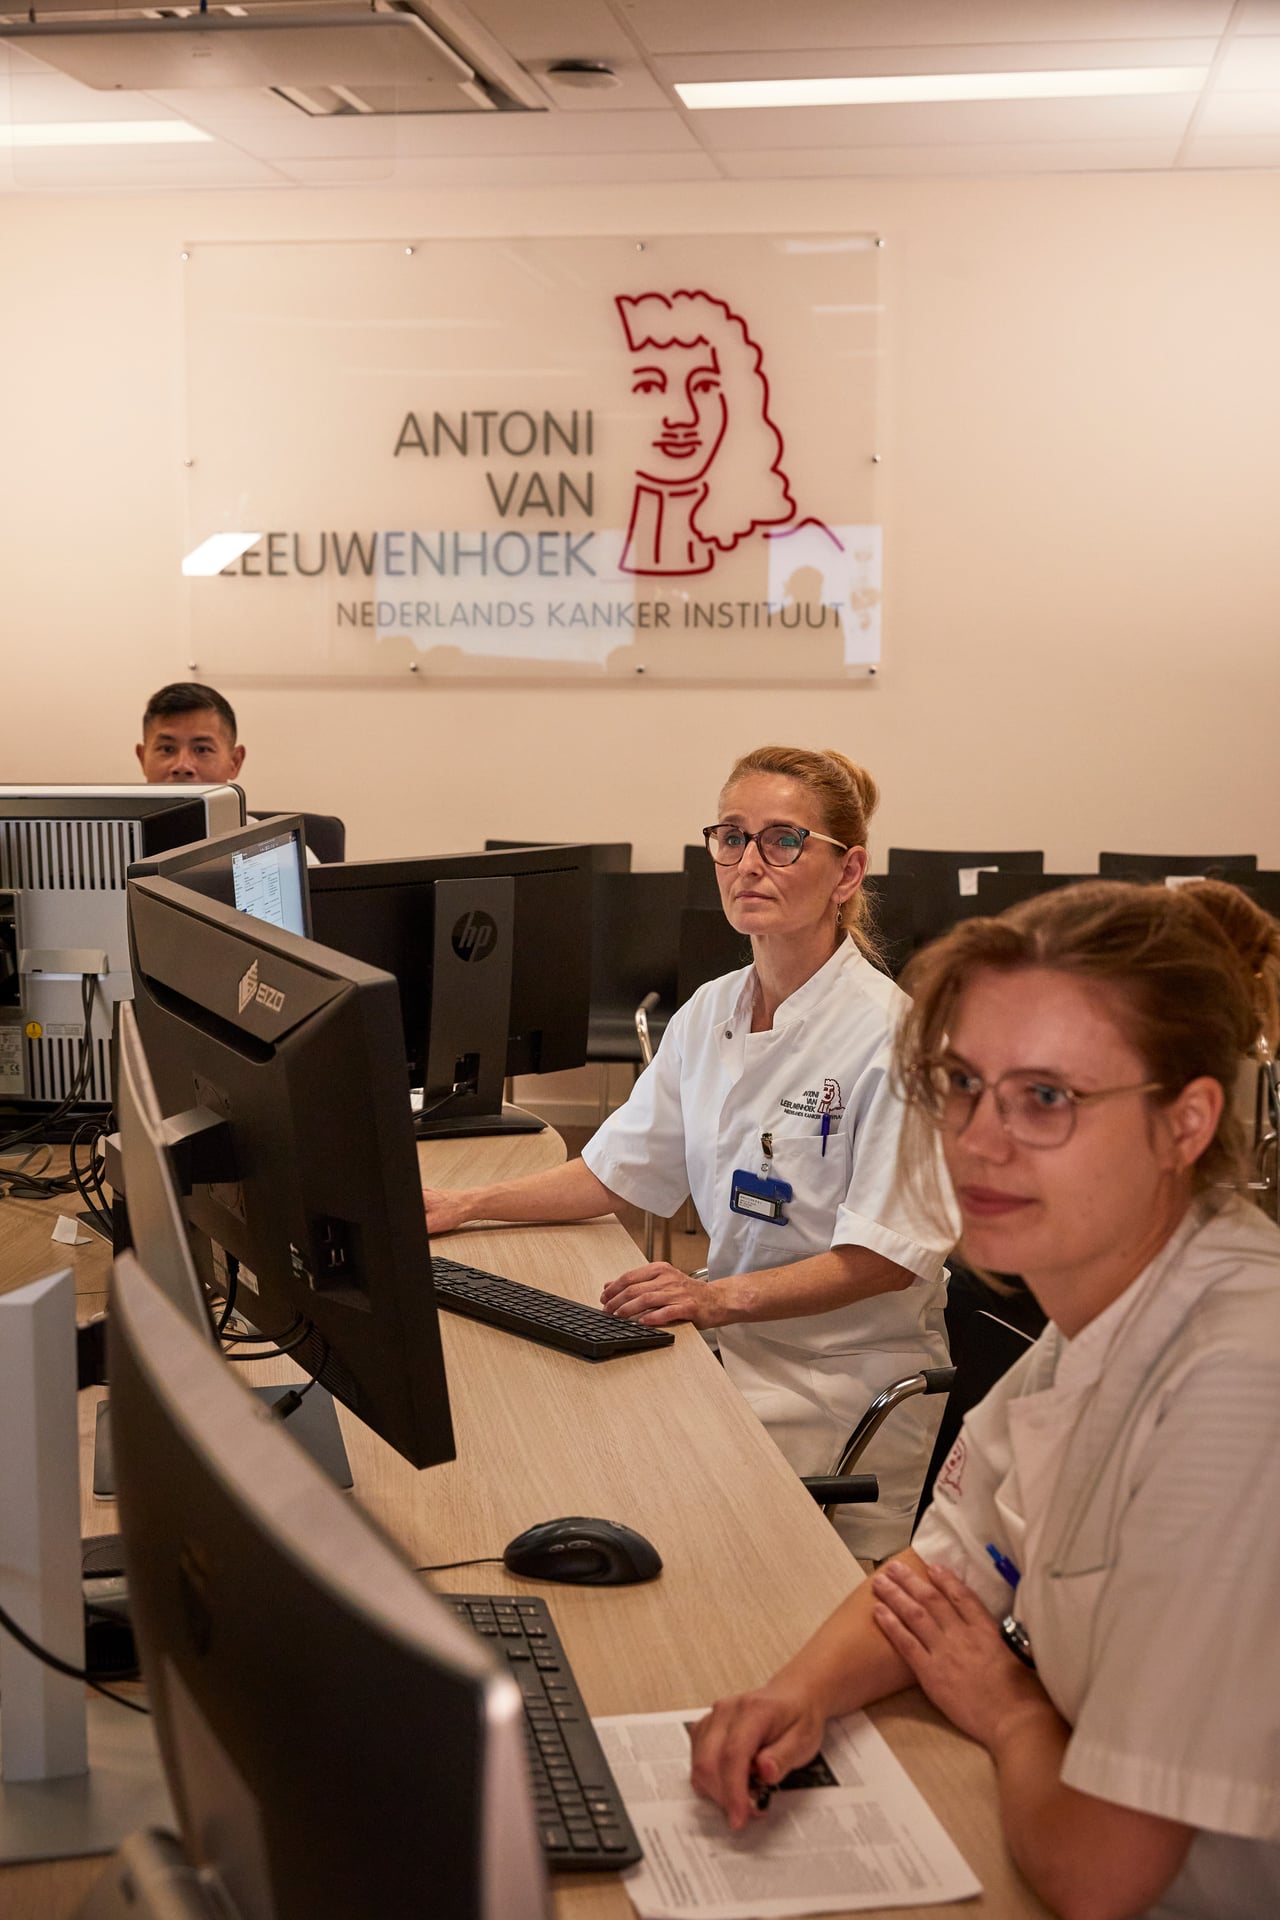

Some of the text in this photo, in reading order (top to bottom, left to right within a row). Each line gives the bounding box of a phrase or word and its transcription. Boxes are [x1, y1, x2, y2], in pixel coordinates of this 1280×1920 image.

[394, 410, 594, 456] ANTONI
[486, 471, 594, 517] VAN
[217, 531, 597, 577] EEUWENHOEK
[336, 601, 845, 630] NEDERLANDS KANKER INSTITUUT
[458, 911, 493, 962] hp
